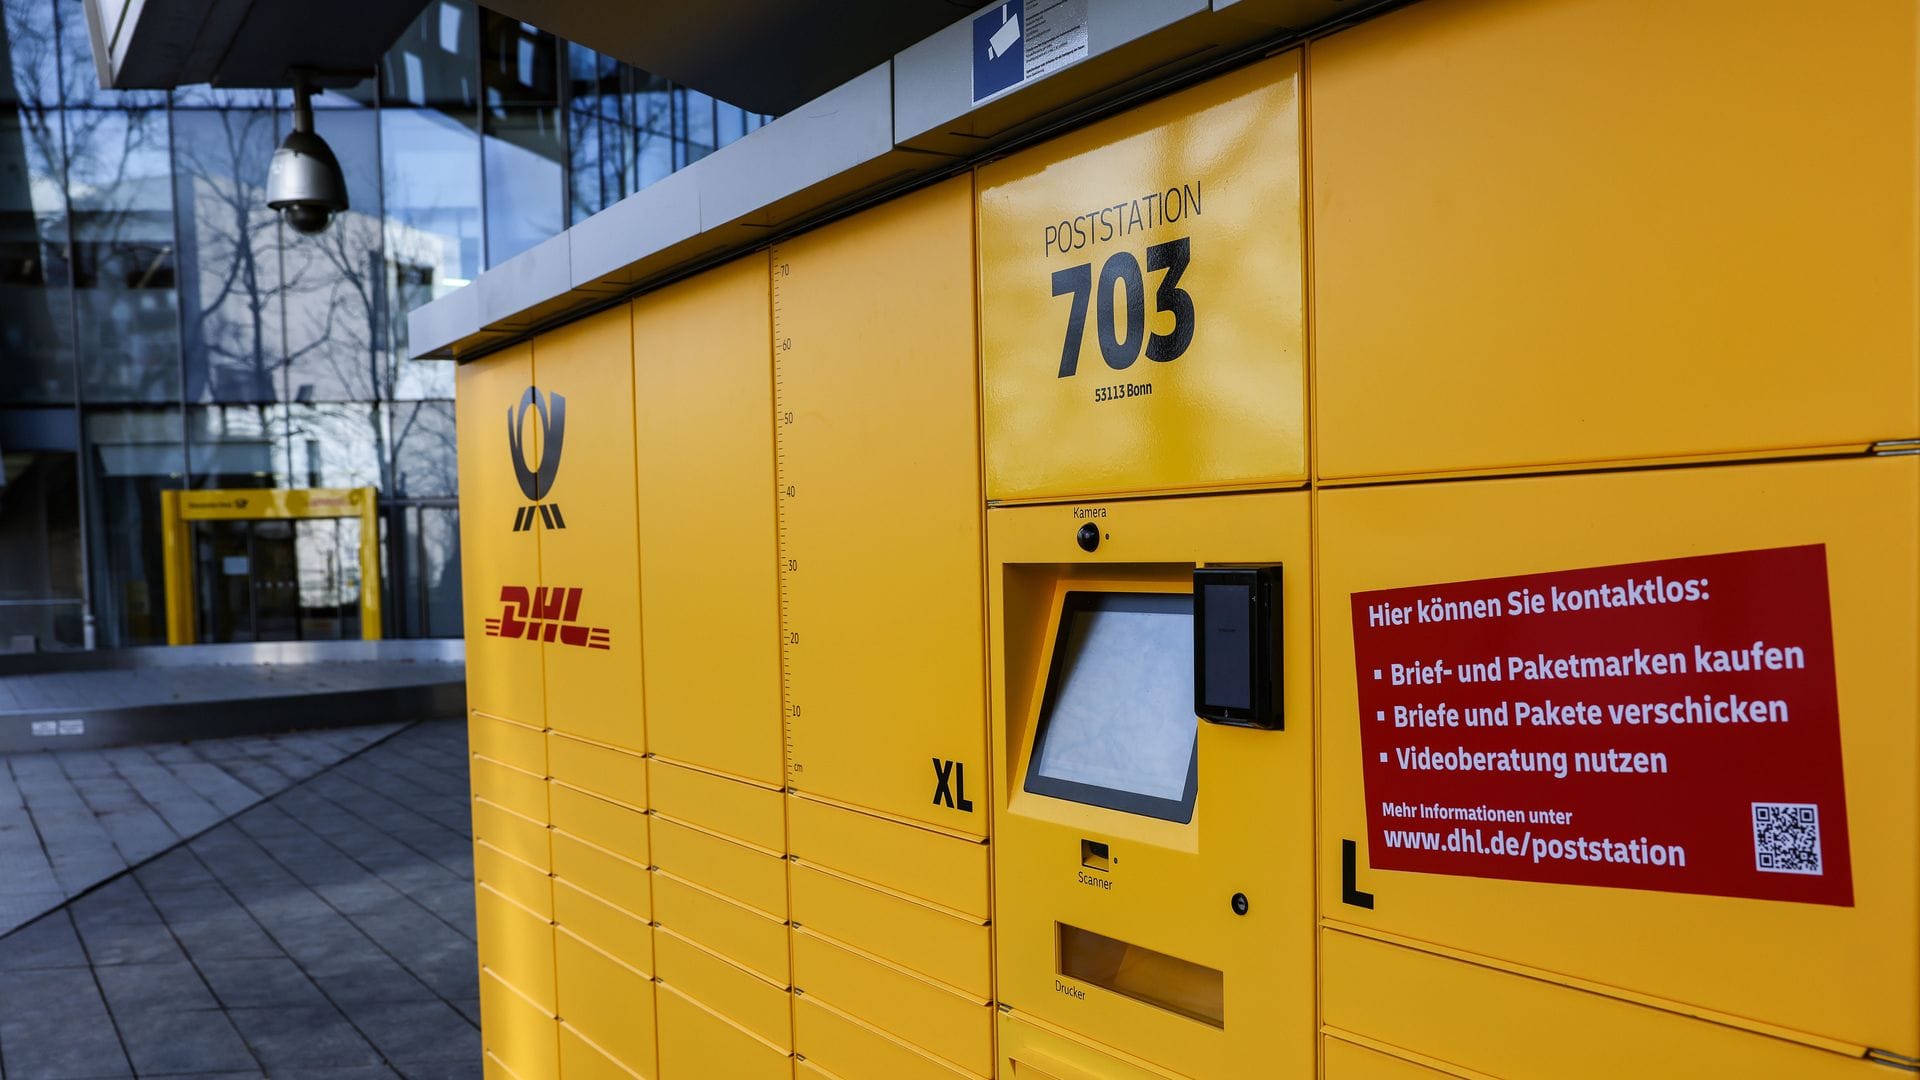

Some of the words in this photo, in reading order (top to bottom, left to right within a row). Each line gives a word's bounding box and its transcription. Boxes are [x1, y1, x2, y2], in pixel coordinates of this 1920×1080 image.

[1044, 180, 1202, 258] POSTSTATION
[780, 263, 790, 278] 70
[1051, 236, 1195, 379] 703
[782, 337, 792, 351] 60
[1095, 384, 1125, 402] 53113
[1126, 383, 1153, 397] Bonn
[784, 411, 794, 425] 50
[786, 485, 796, 498] 40
[1073, 506, 1107, 519] Kamera
[788, 559, 798, 572] 30
[1368, 602, 1413, 627] Hier
[1417, 597, 1502, 623] können
[1507, 588, 1546, 616] Sie
[1550, 575, 1710, 612] kontaktlos:
[500, 586, 590, 647] DHL
[790, 632, 800, 645] 20
[1390, 659, 1453, 686] Brief-
[1457, 656, 1502, 683] und
[1507, 648, 1688, 681] Paketmarken
[1693, 641, 1805, 673] kaufen
[792, 704, 801, 718] 10
[1393, 703, 1460, 728] Briefe
[1465, 701, 1509, 727] und
[1514, 700, 1602, 727] Pakete
[1607, 694, 1789, 725] verschicken
[793, 763, 803, 773] cm
[1395, 746, 1569, 779] Videoberatung
[1574, 748, 1669, 774] nutzen
[931, 757, 974, 813] XL
[1381, 802, 1418, 818] Mehr
[1420, 803, 1526, 824] Informationen
[1529, 810, 1573, 825] unter
[1384, 827, 1686, 867] www.dhl.de/poststation
[1078, 871, 1113, 891] Scanner
[1342, 838, 1375, 911] L
[1055, 979, 1086, 1001] Drucker
